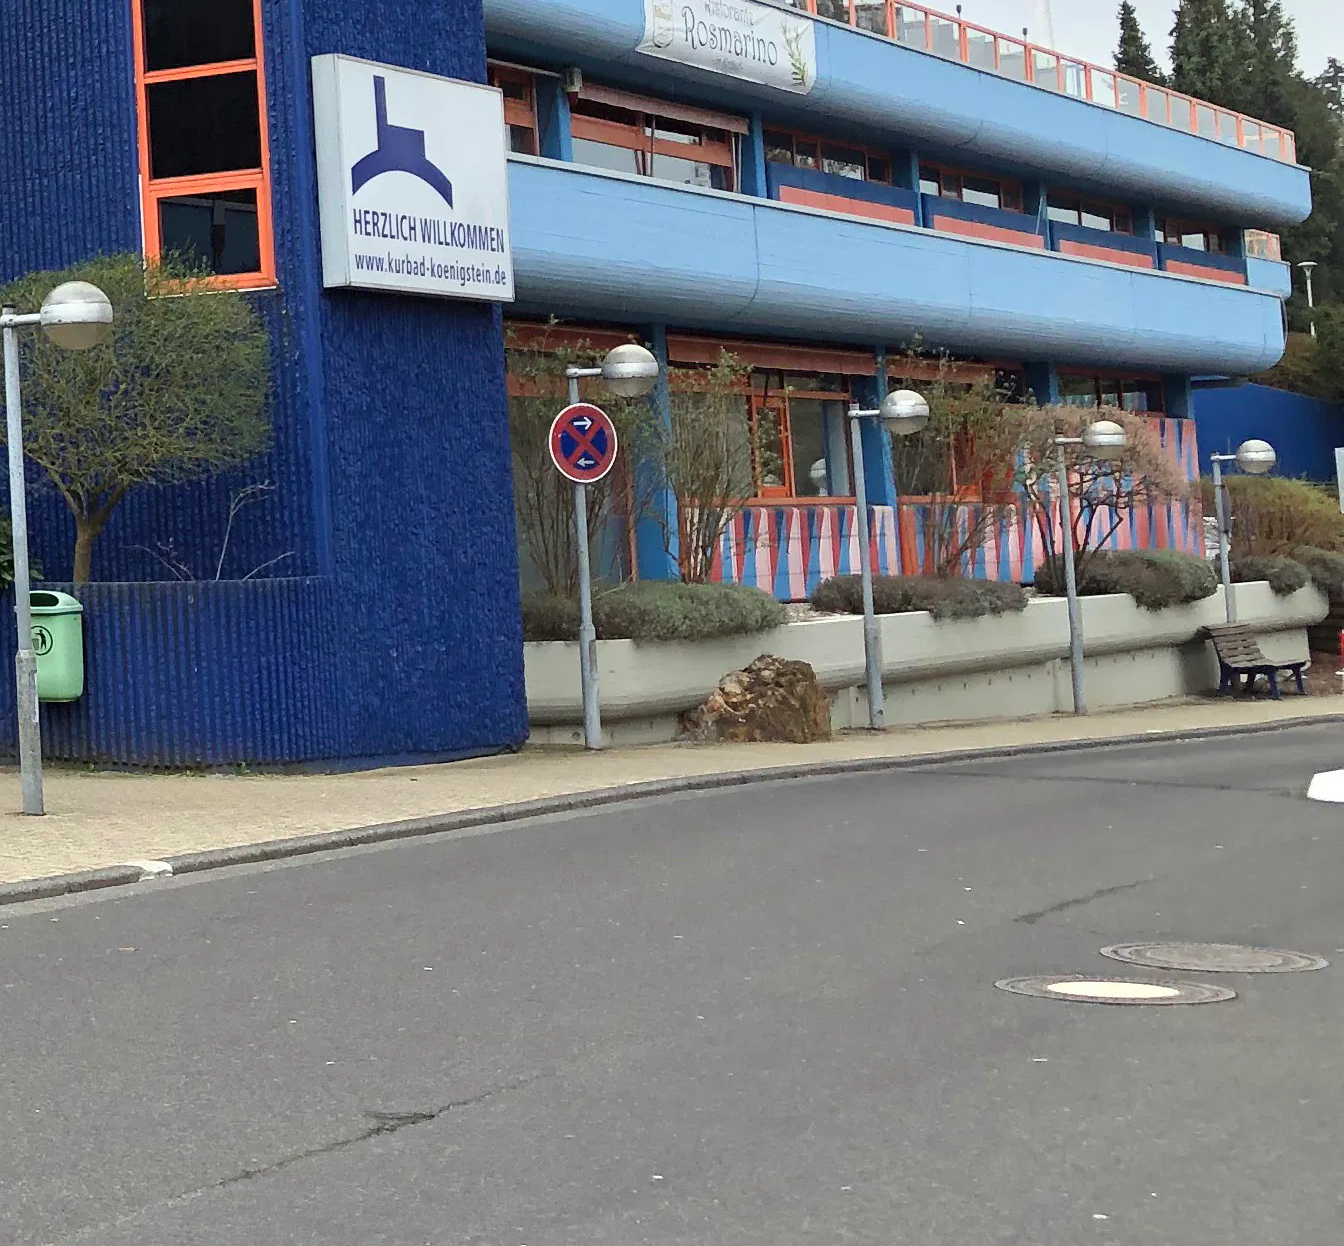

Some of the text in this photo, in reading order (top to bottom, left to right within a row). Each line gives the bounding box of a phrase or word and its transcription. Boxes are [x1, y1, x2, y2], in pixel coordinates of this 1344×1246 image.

[681, 5, 778, 66] Rosmarino
[353, 208, 505, 253] HERZLICH WILLKOMMEN
[354, 251, 507, 287] www.kurbad-koenigstein.de
